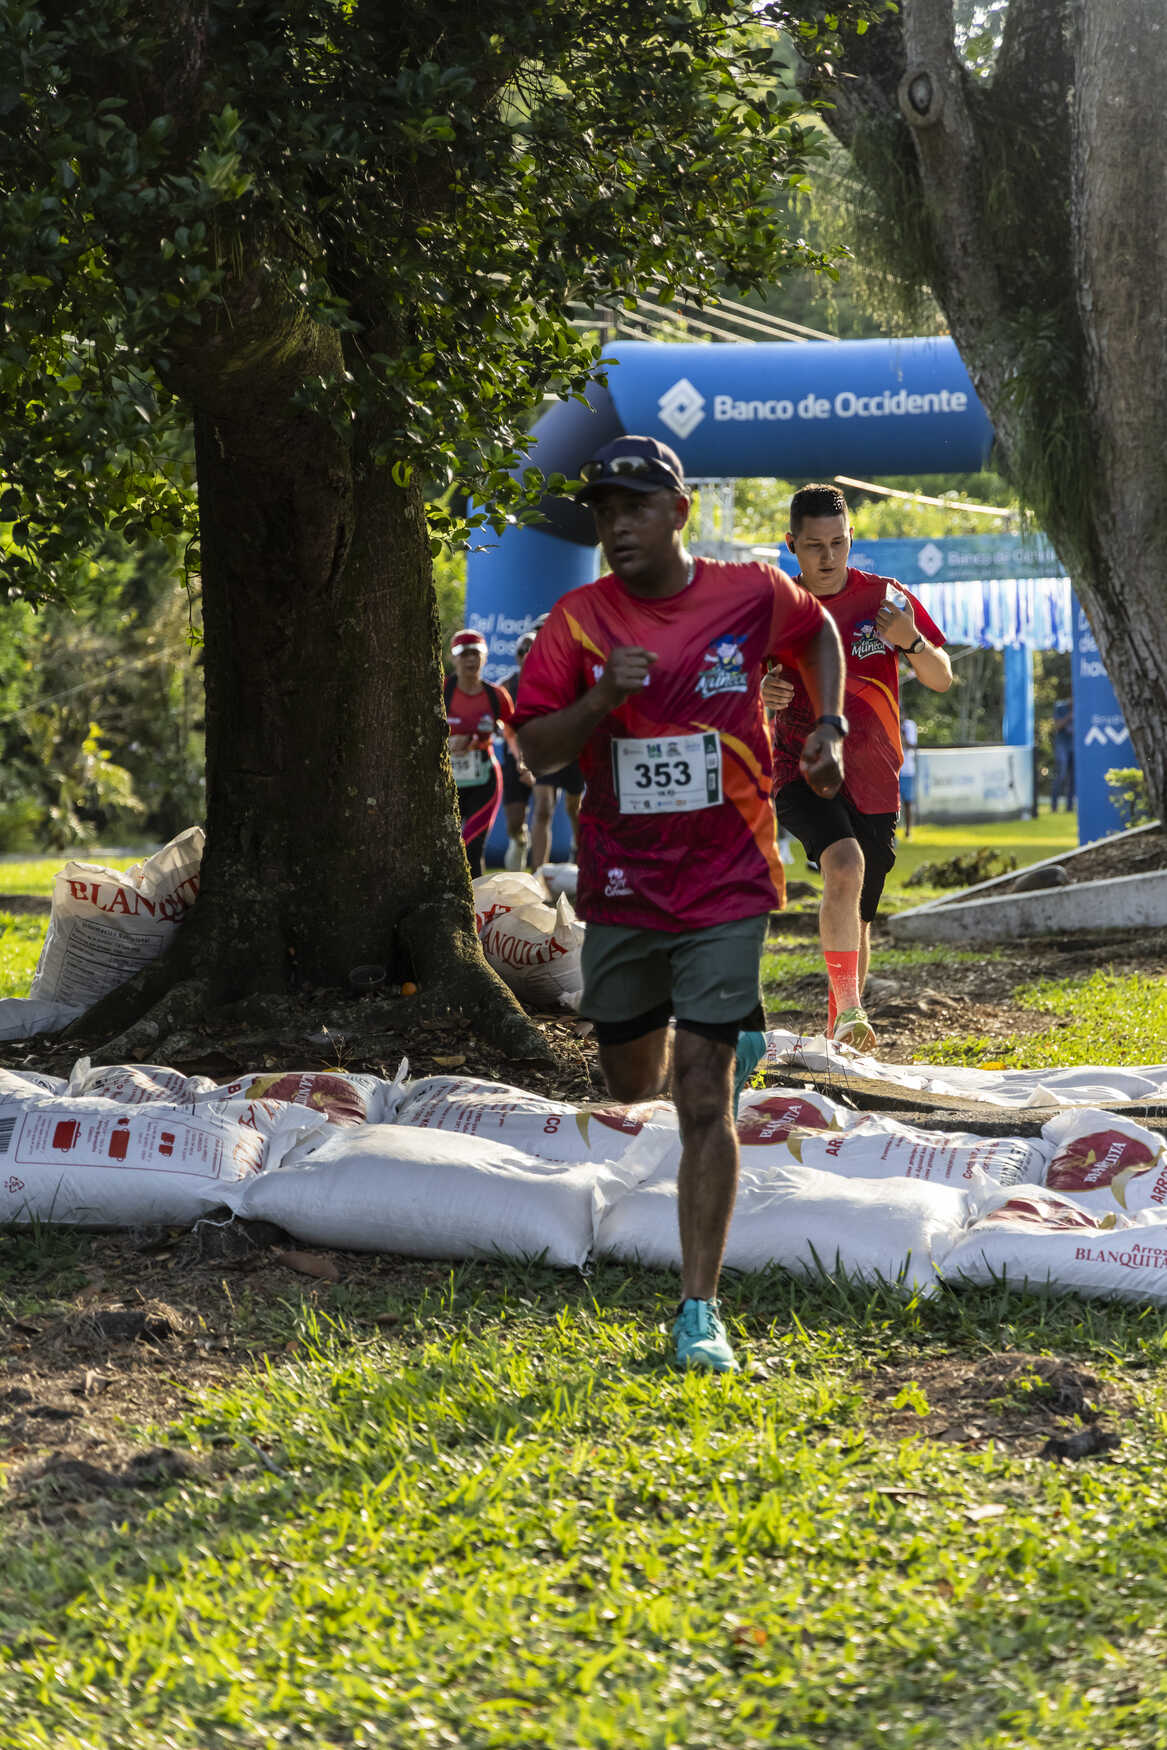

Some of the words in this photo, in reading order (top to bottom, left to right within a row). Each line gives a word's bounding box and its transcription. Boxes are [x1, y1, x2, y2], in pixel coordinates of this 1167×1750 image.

[713, 395, 794, 421] Banco
[798, 393, 831, 419] de
[834, 389, 967, 418] Occidente
[634, 761, 692, 788] 353
